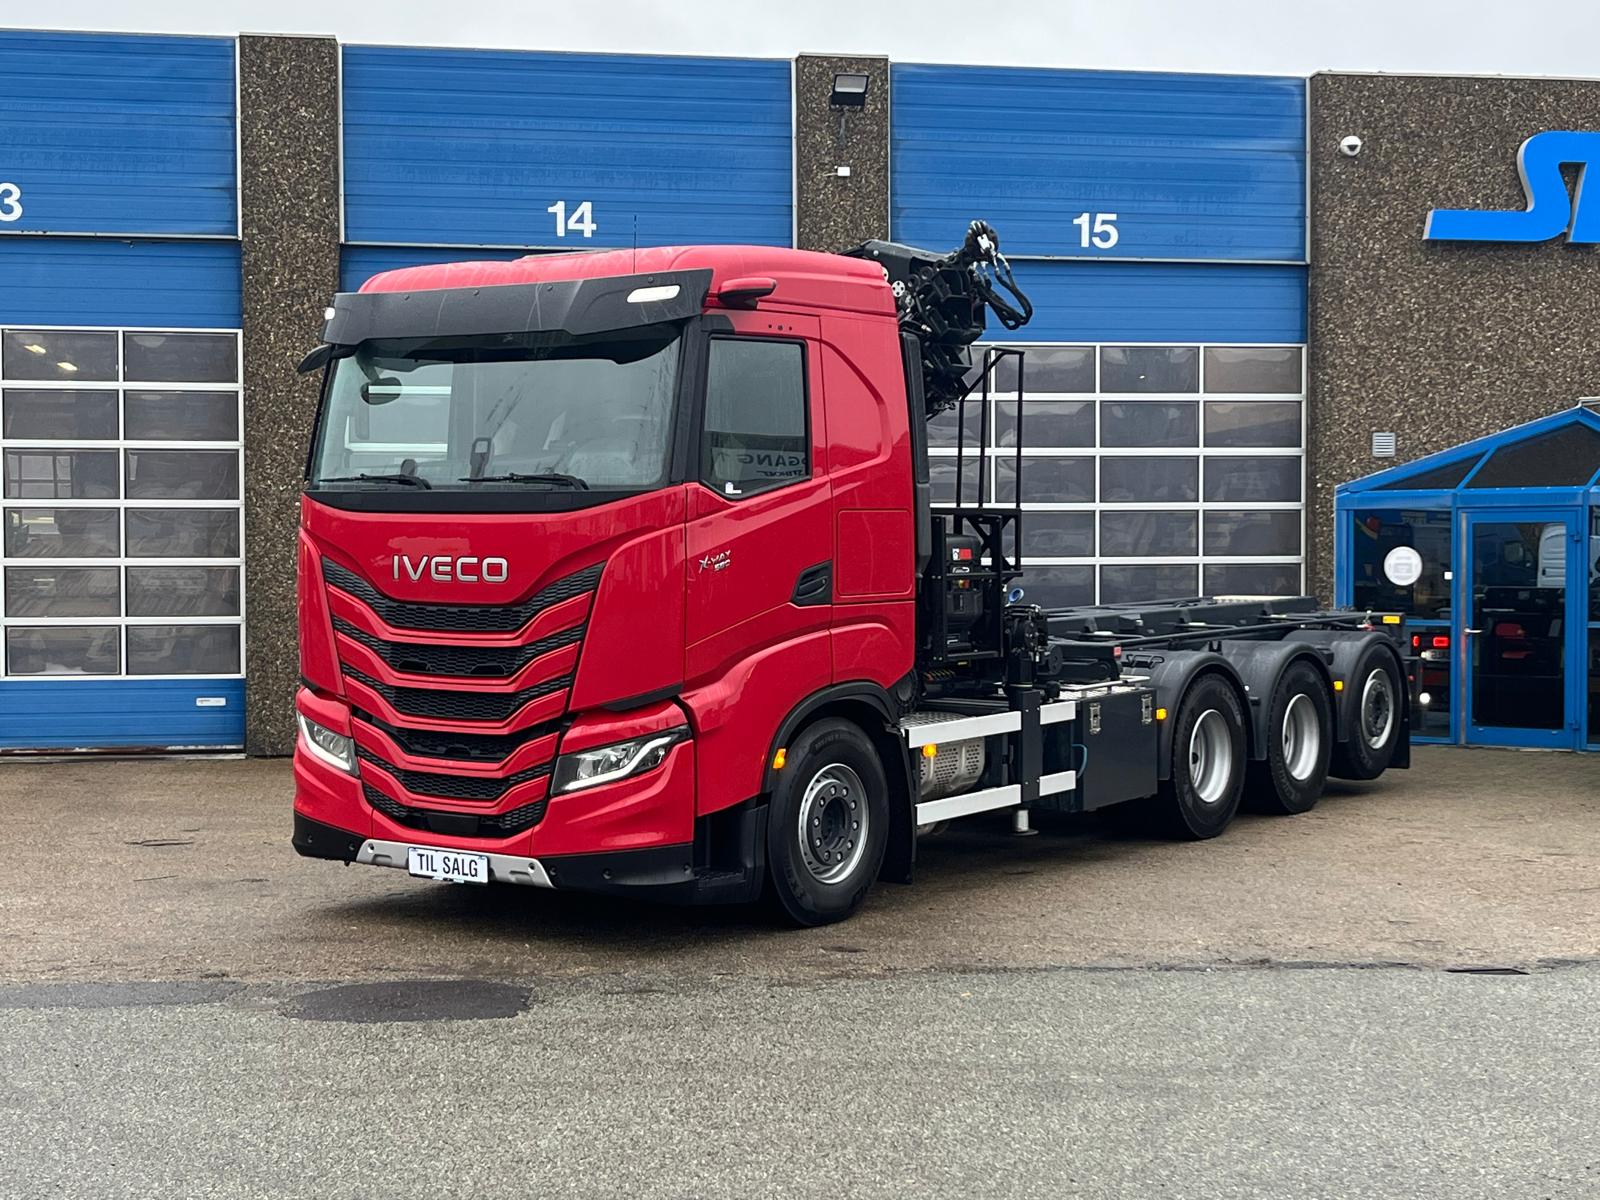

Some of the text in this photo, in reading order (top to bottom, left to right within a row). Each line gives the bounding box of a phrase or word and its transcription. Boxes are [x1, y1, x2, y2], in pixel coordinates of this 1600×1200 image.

[0, 182, 23, 222] 3
[547, 200, 597, 238] 14
[1072, 212, 1119, 249] 15
[393, 555, 508, 582] IVECO
[417, 853, 478, 877] TIL SALG
